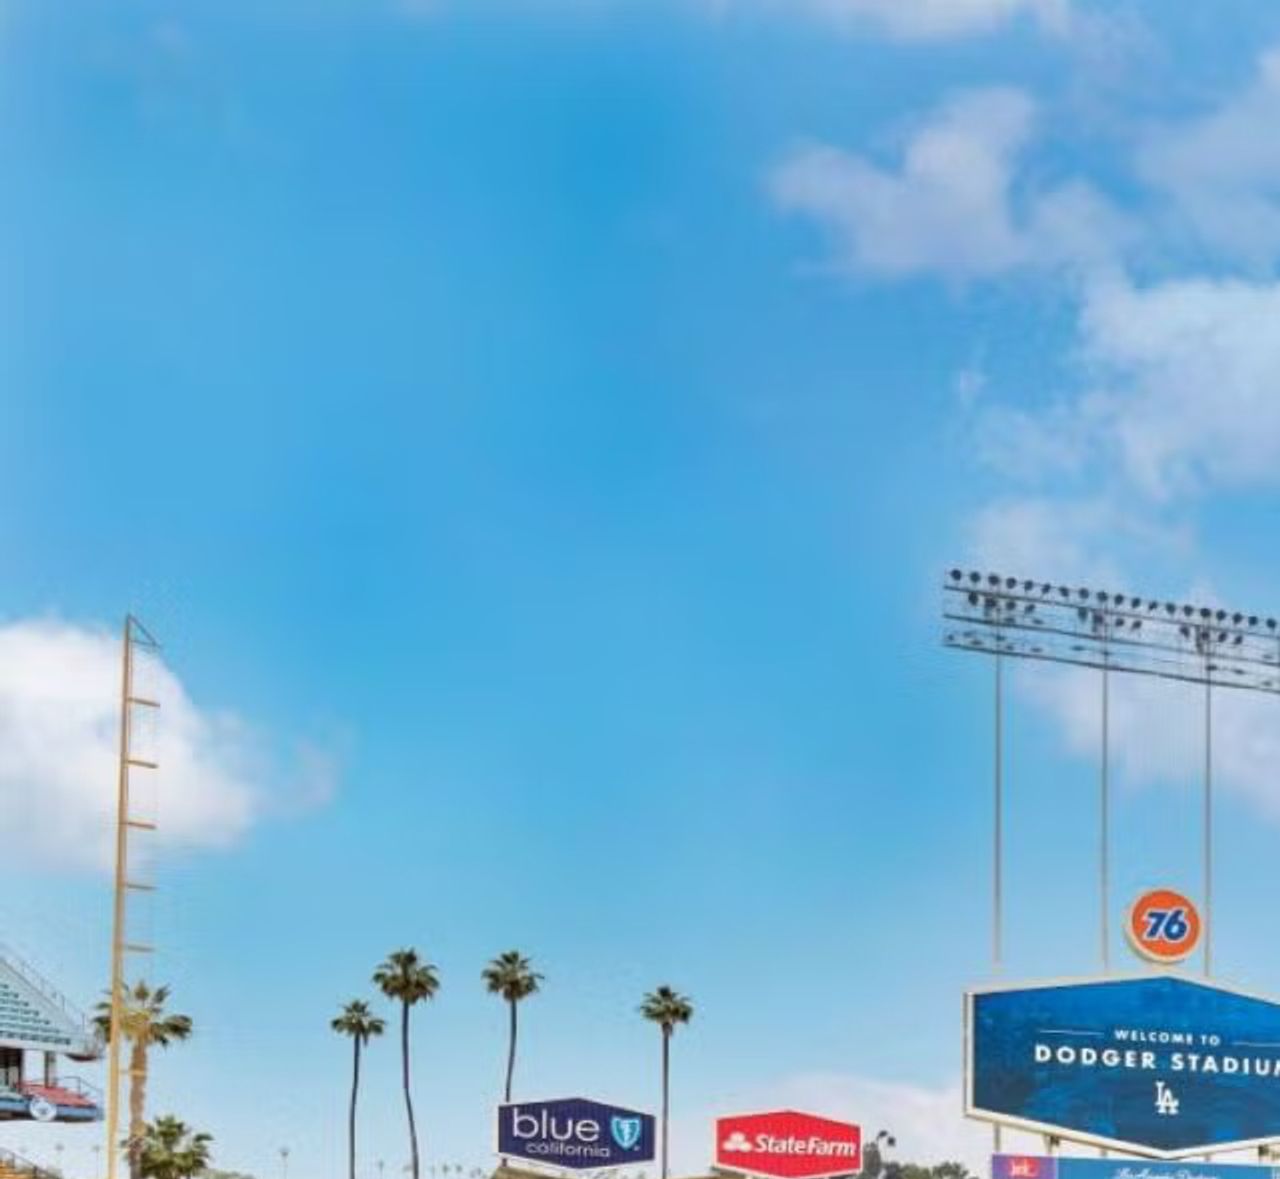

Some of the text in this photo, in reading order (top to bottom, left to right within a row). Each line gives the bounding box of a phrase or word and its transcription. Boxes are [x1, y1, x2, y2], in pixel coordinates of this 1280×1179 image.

[1144, 908, 1188, 942] 76
[1115, 1029, 1221, 1046] WELCOME TO
[1034, 1044, 1157, 1070] DODGER
[1155, 1081, 1180, 1115] LA
[512, 1108, 600, 1142] blue
[526, 1140, 610, 1158] california
